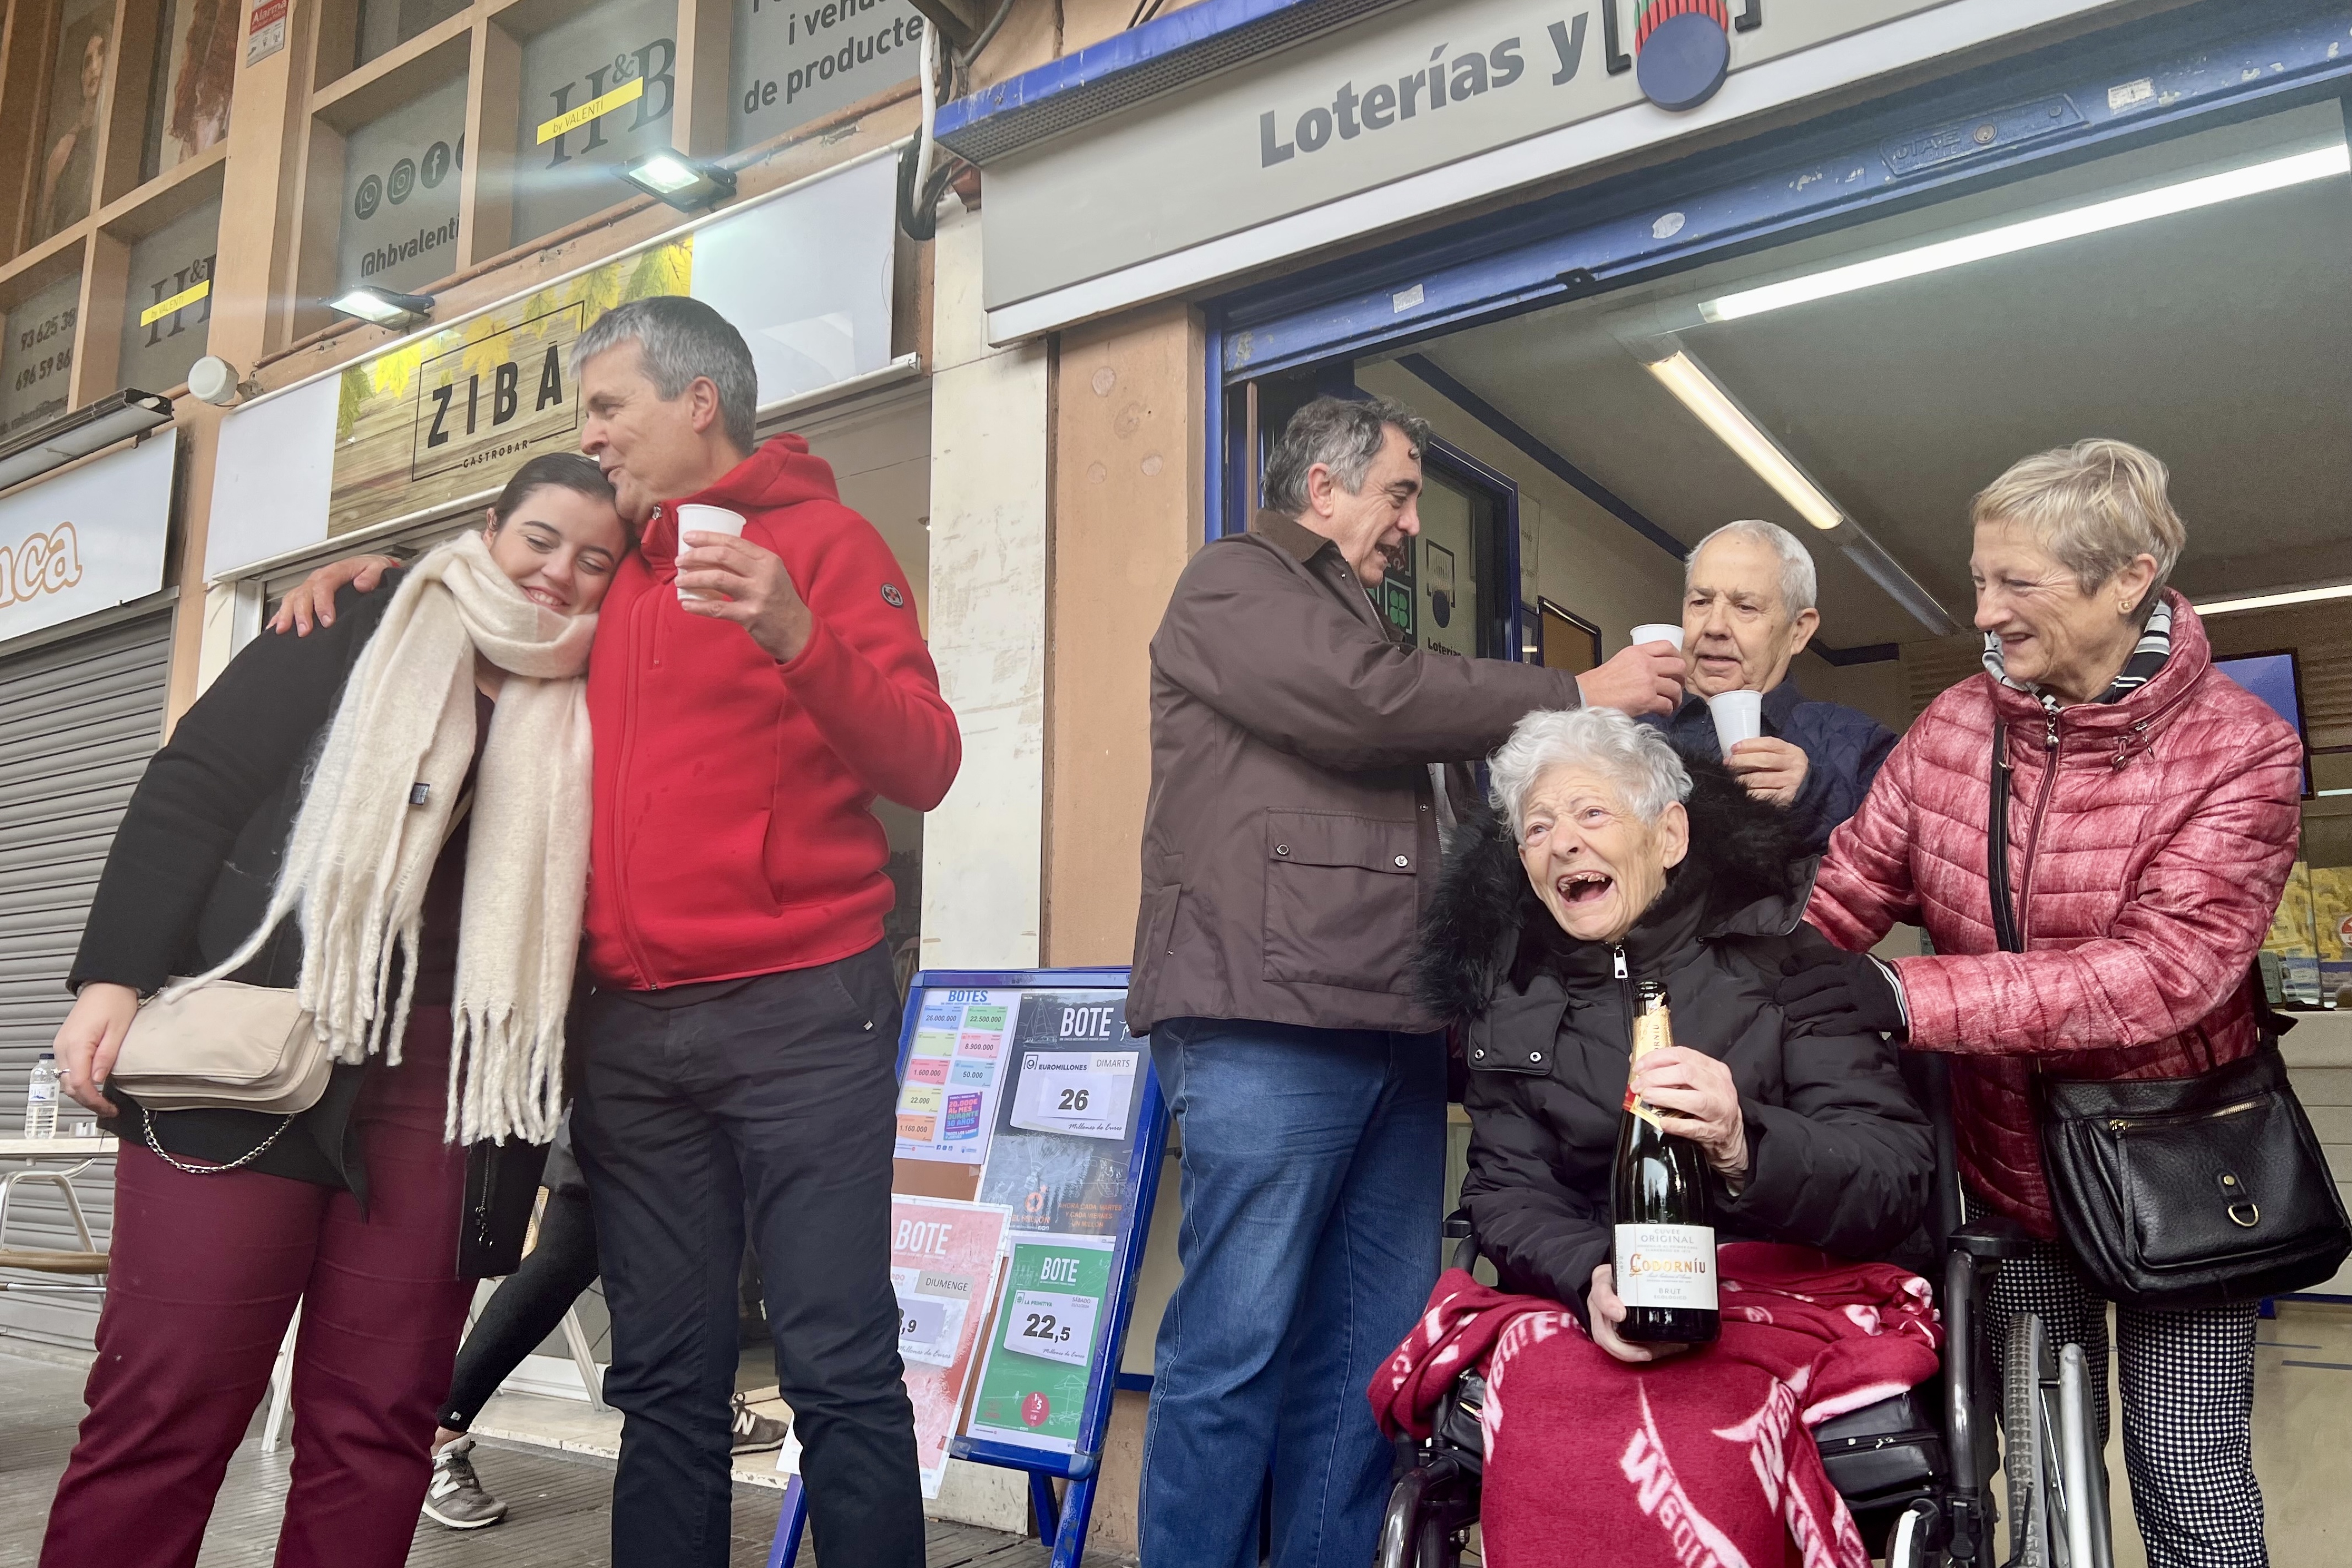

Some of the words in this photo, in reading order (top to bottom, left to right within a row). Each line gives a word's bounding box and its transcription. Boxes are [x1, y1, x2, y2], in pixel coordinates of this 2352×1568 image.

[252, 0, 286, 25] Alarma
[789, 13, 795, 45] i
[744, 80, 777, 114] de
[787, 15, 923, 104] producte
[1260, 36, 1525, 168] Loterías
[1547, 11, 1589, 86] y
[553, 122, 562, 133] by
[21, 329, 34, 351] 93
[36, 315, 58, 343] 625
[15, 364, 36, 391] 696
[39, 357, 53, 380] 59
[56, 348, 70, 372] 86
[463, 440, 528, 468] GASTROBAR
[948, 990, 988, 1002] BOTES
[1060, 1008, 1114, 1037] BOTE
[1096, 1059, 1130, 1068] DIMARTS
[1058, 1089, 1089, 1110] 26
[948, 1110, 979, 1120] DURANTE
[895, 1219, 952, 1255] BOTE
[1641, 1235, 1694, 1244] ORIGINAL
[1041, 1257, 1080, 1283] BOTE
[925, 1277, 968, 1292] DIUMENGE
[1023, 1313, 1071, 1343] 22,5
[899, 1346, 923, 1354] Millones
[933, 1349, 951, 1359] Euros
